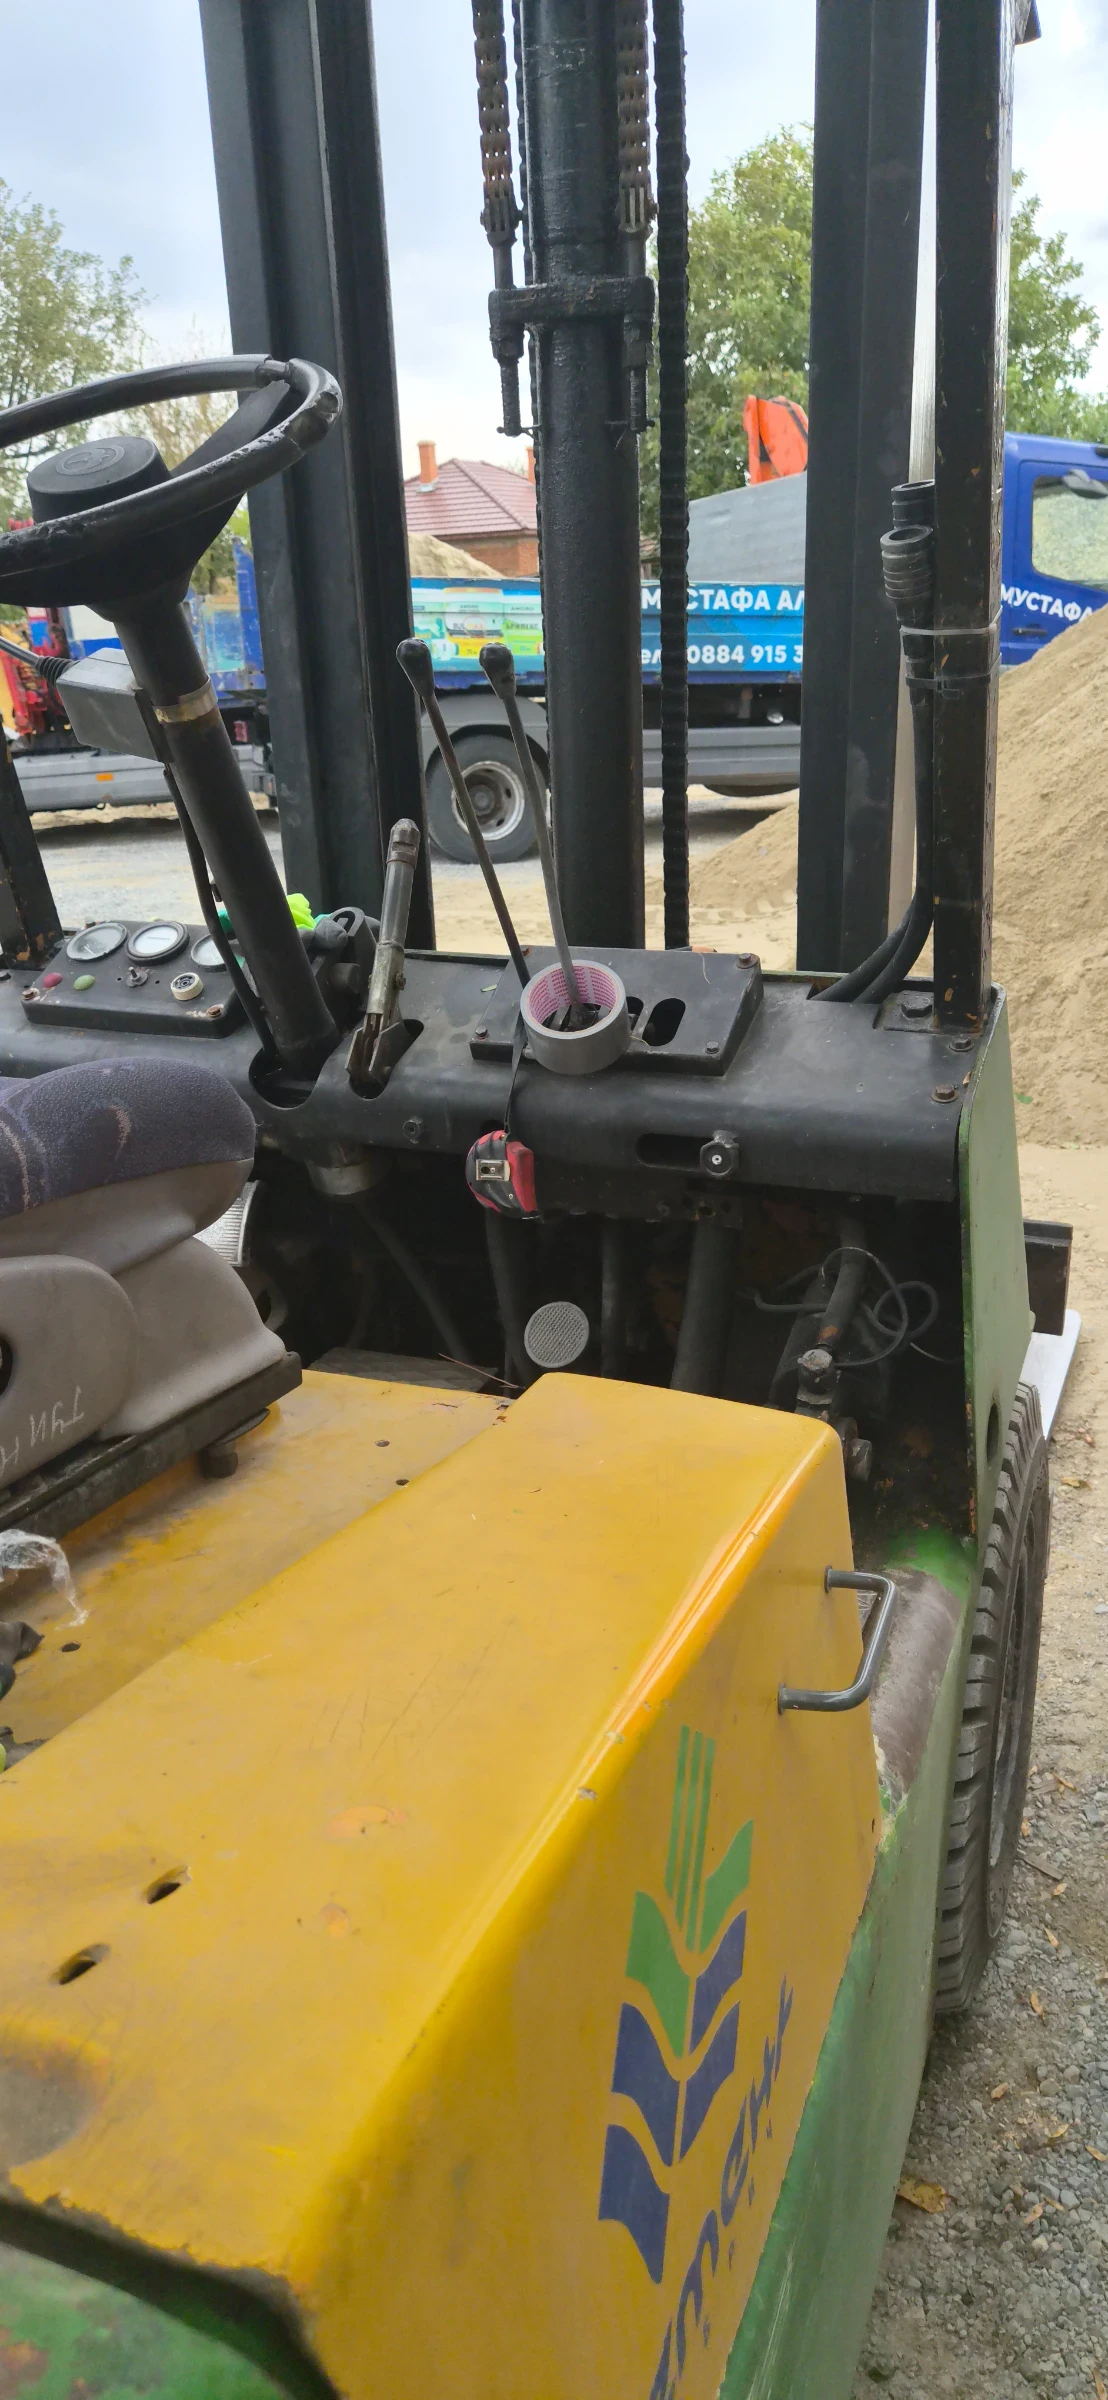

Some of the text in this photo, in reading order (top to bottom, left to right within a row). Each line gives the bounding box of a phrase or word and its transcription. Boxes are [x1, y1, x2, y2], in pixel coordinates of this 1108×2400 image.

[641, 587, 771, 612] МСТАФА
[687, 645, 745, 665] 0884
[751, 645, 787, 665] 915
